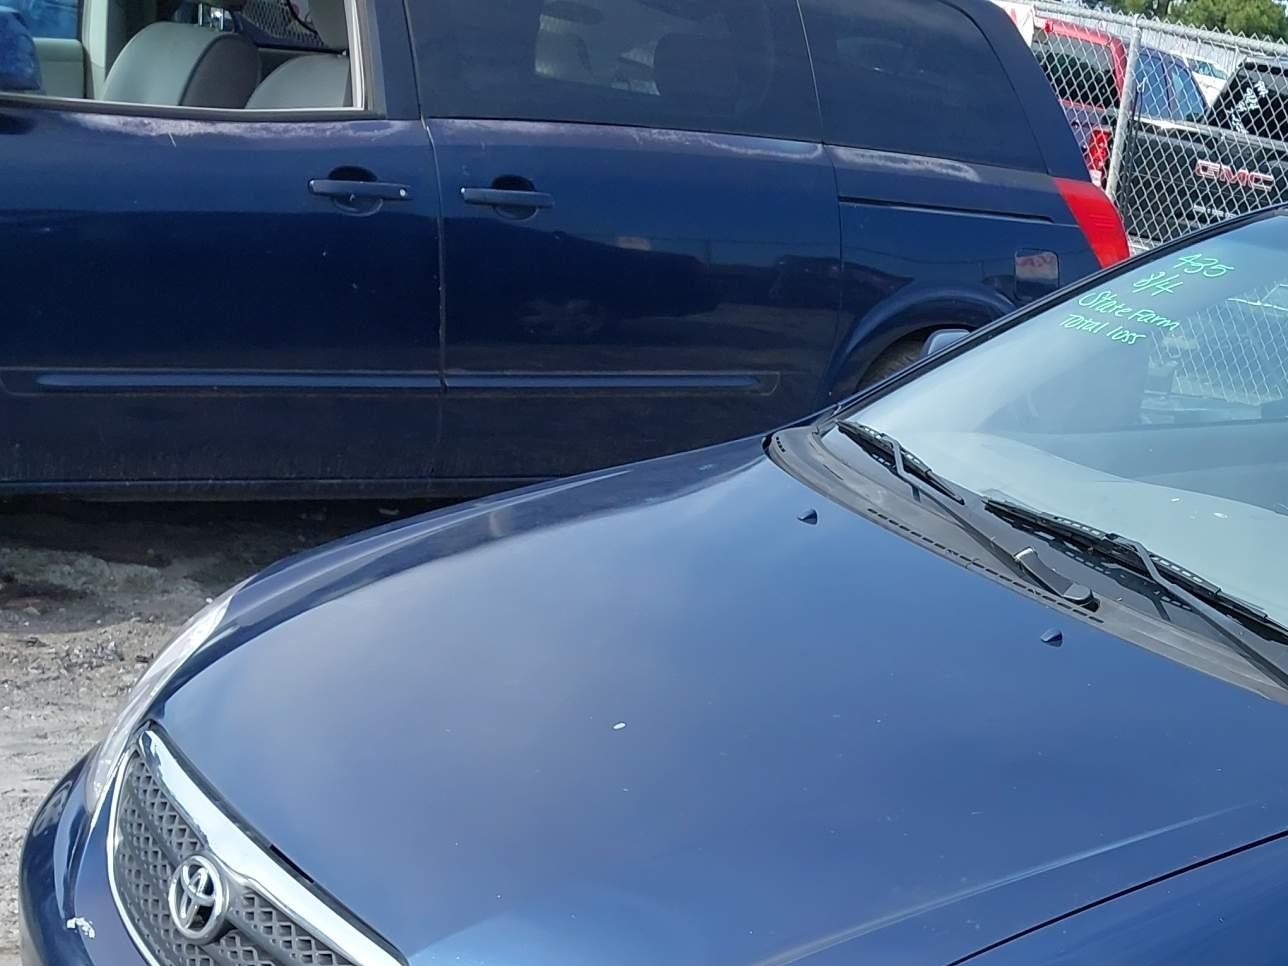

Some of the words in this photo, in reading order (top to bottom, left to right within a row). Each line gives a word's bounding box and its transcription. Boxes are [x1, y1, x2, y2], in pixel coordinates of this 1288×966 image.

[1195, 160, 1274, 192] GMC
[1174, 254, 1234, 277] 435
[1059, 314, 1105, 333] Total
[1079, 290, 1129, 317] State
[1128, 309, 1180, 331] Farm
